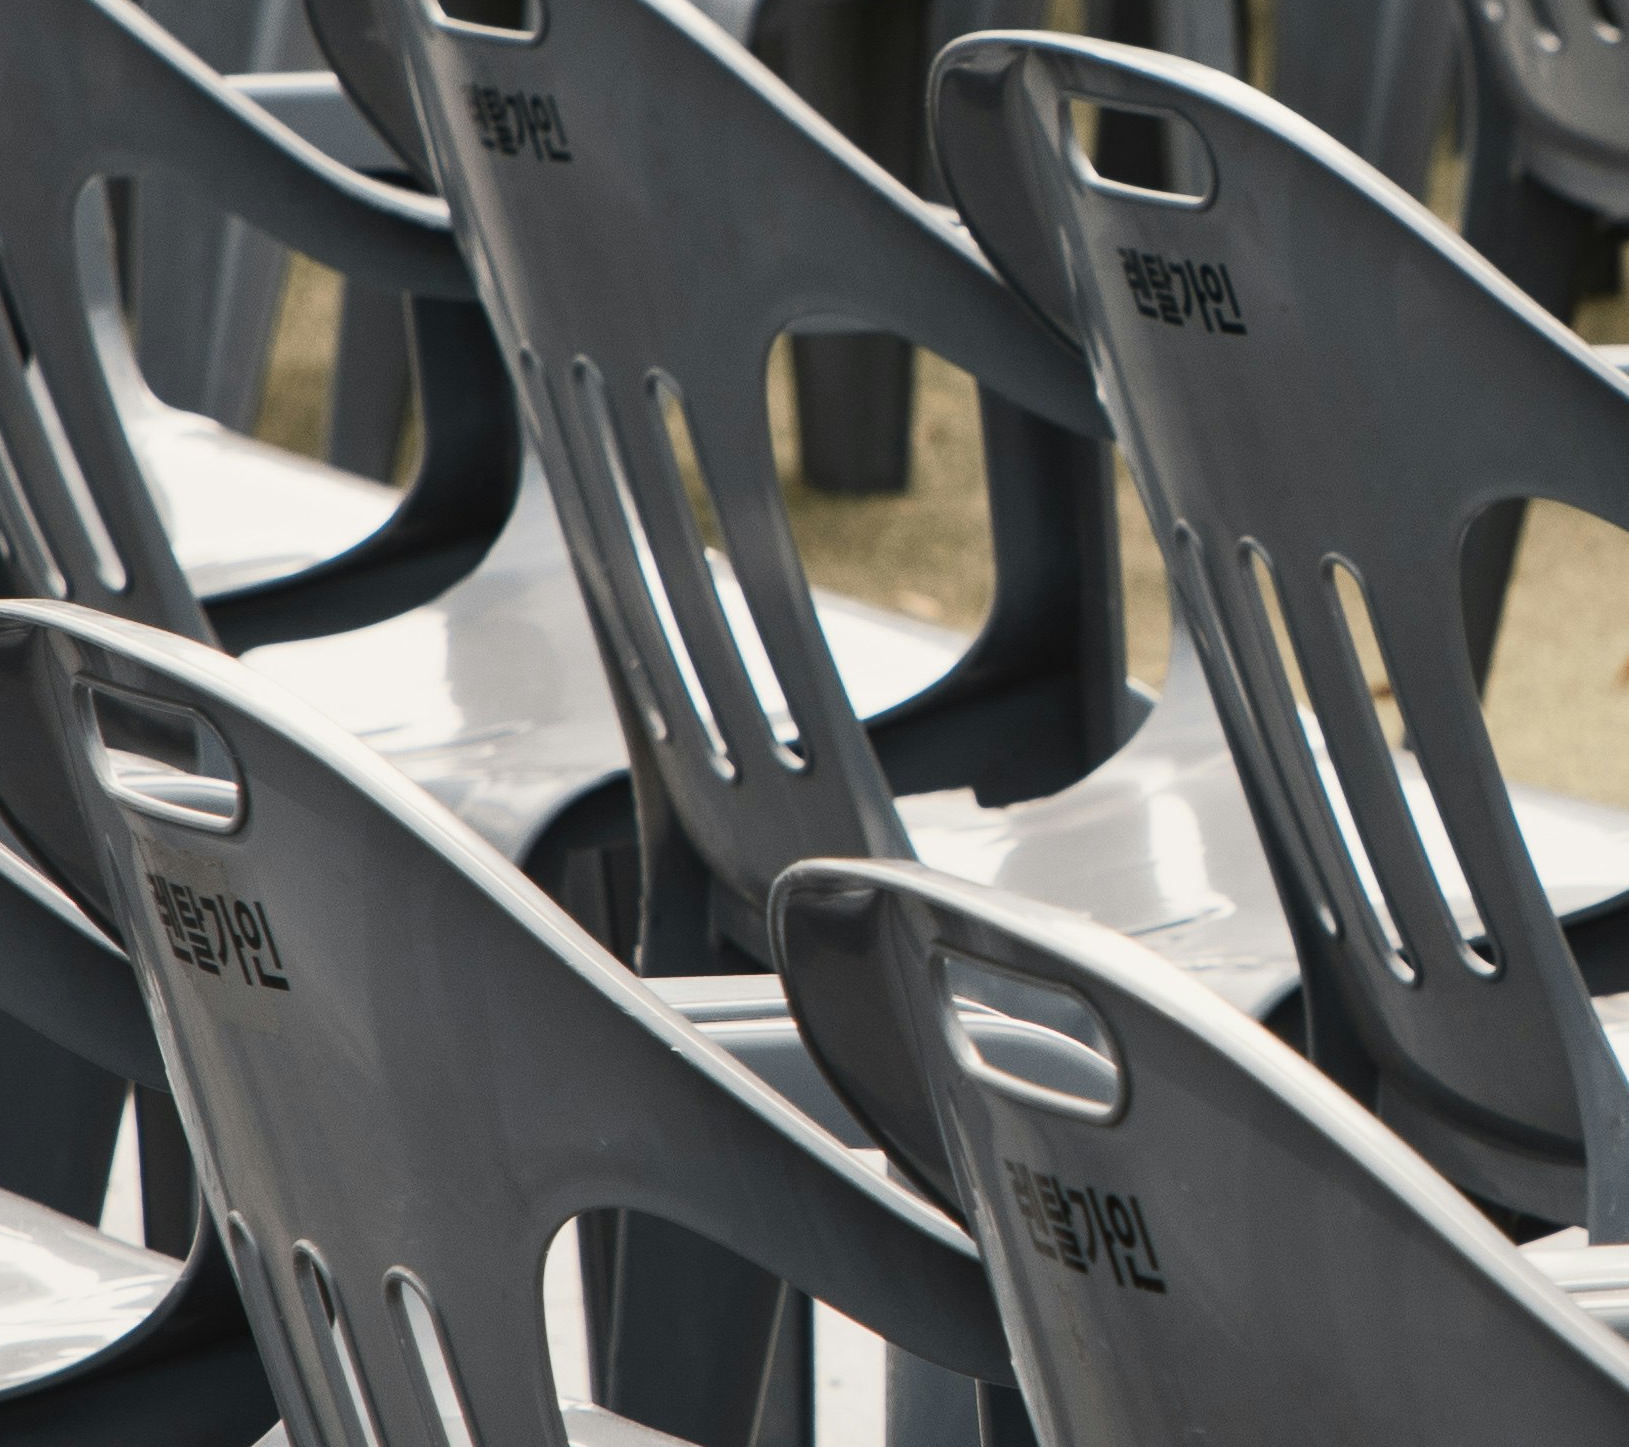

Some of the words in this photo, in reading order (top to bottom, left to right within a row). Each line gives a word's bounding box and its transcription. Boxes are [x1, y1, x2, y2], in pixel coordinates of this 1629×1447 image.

[1117, 248, 1248, 336] 렌탈가인
[146, 872, 291, 992] 렌탈가인
[1004, 1158, 1167, 1294] 렌탈가인
